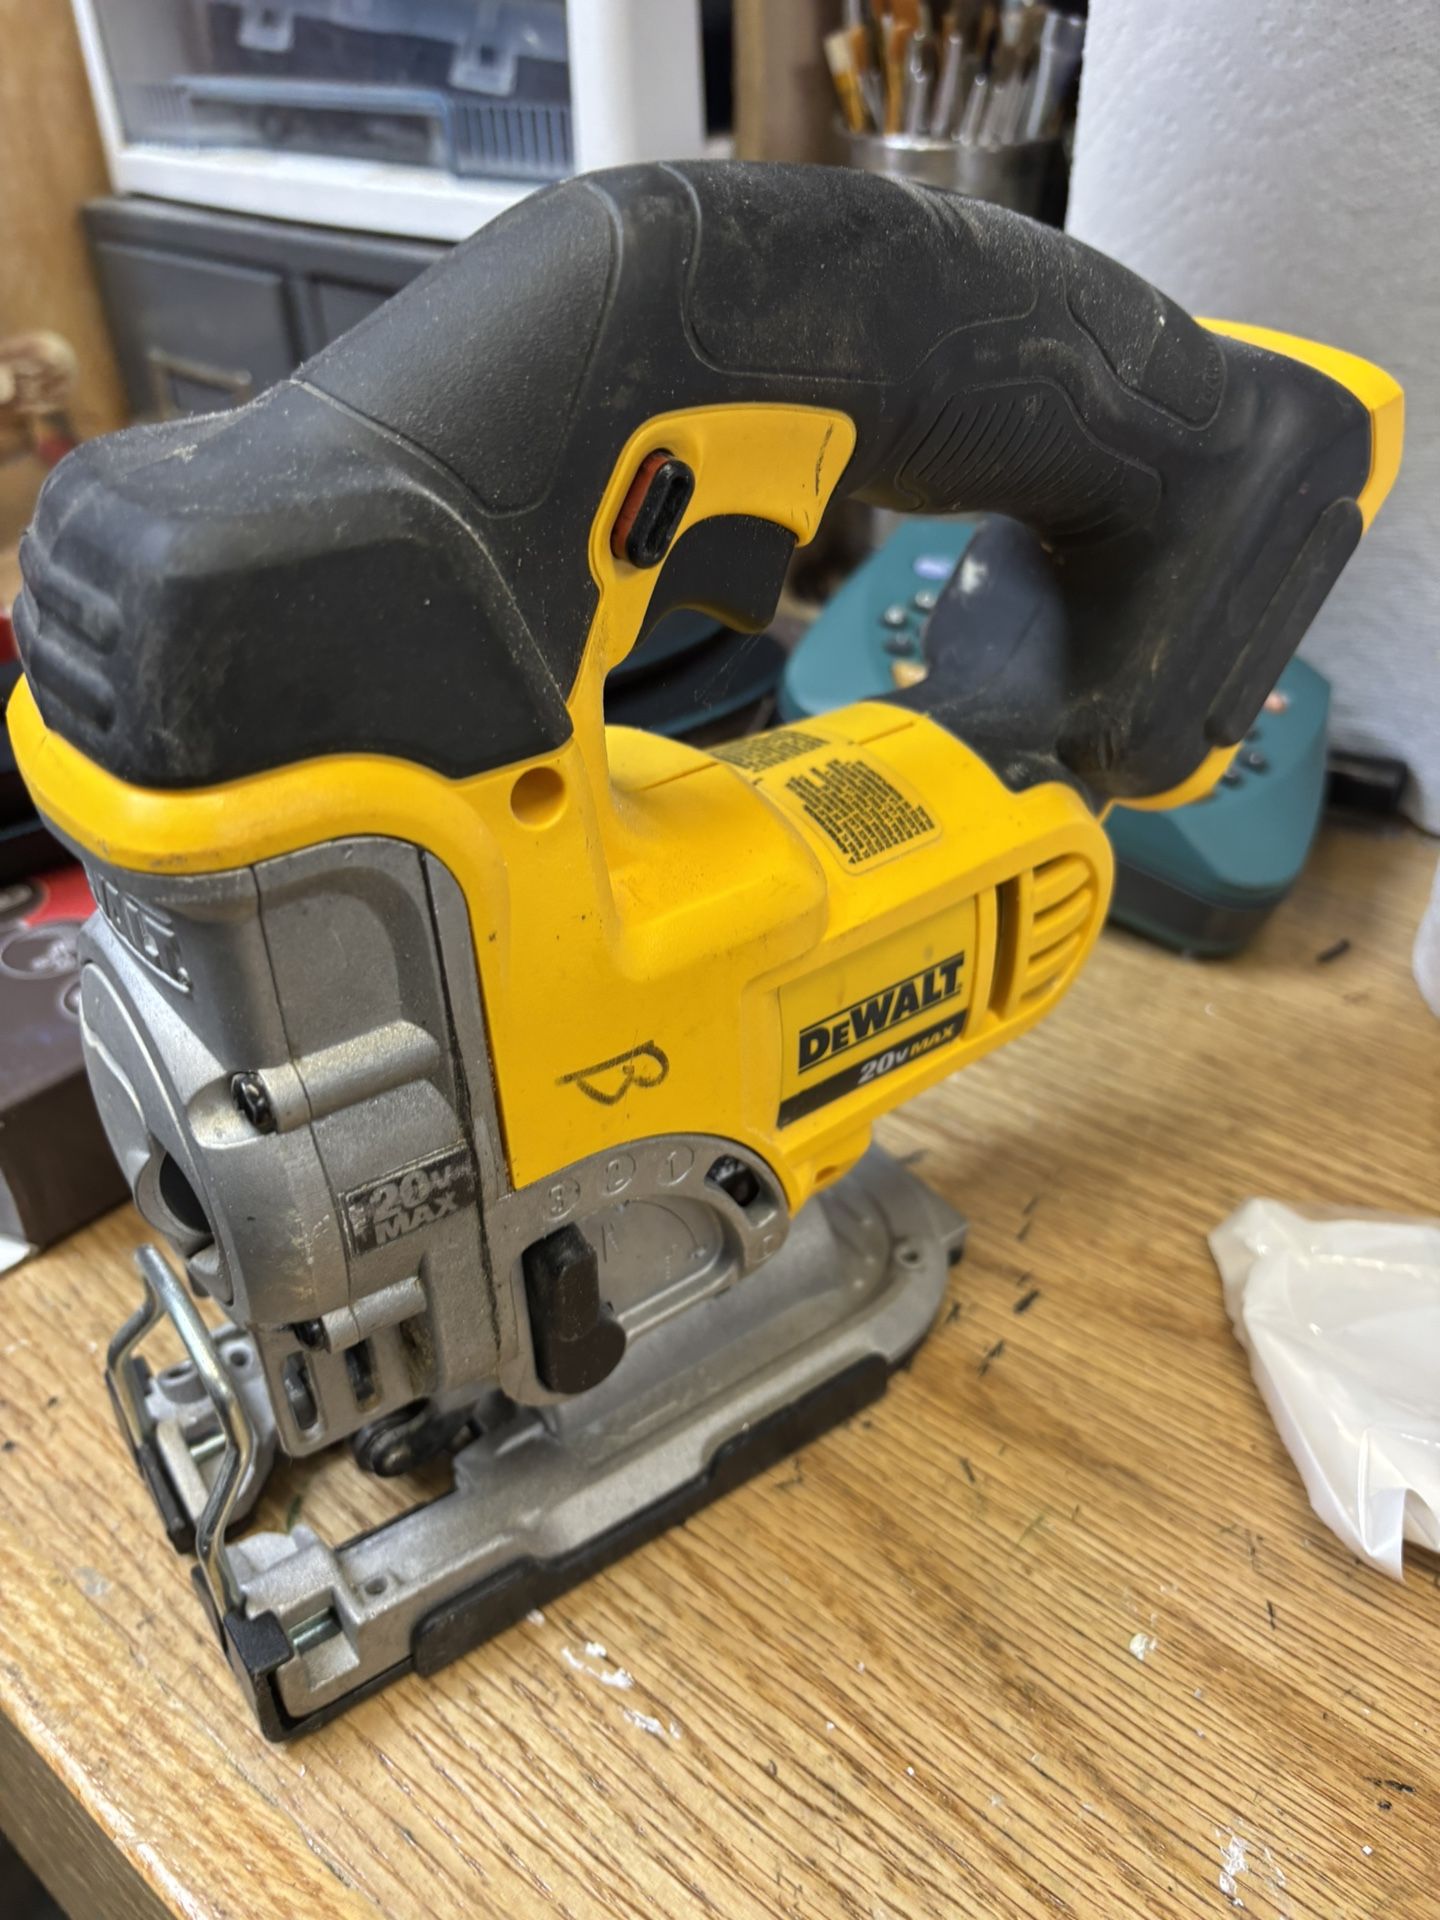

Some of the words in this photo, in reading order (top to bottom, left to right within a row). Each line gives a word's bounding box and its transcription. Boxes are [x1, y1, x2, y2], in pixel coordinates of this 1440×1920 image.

[799, 956, 964, 1071] DEWALT
[910, 1024, 955, 1056] MAX
[375, 1191, 457, 1245] MAX
